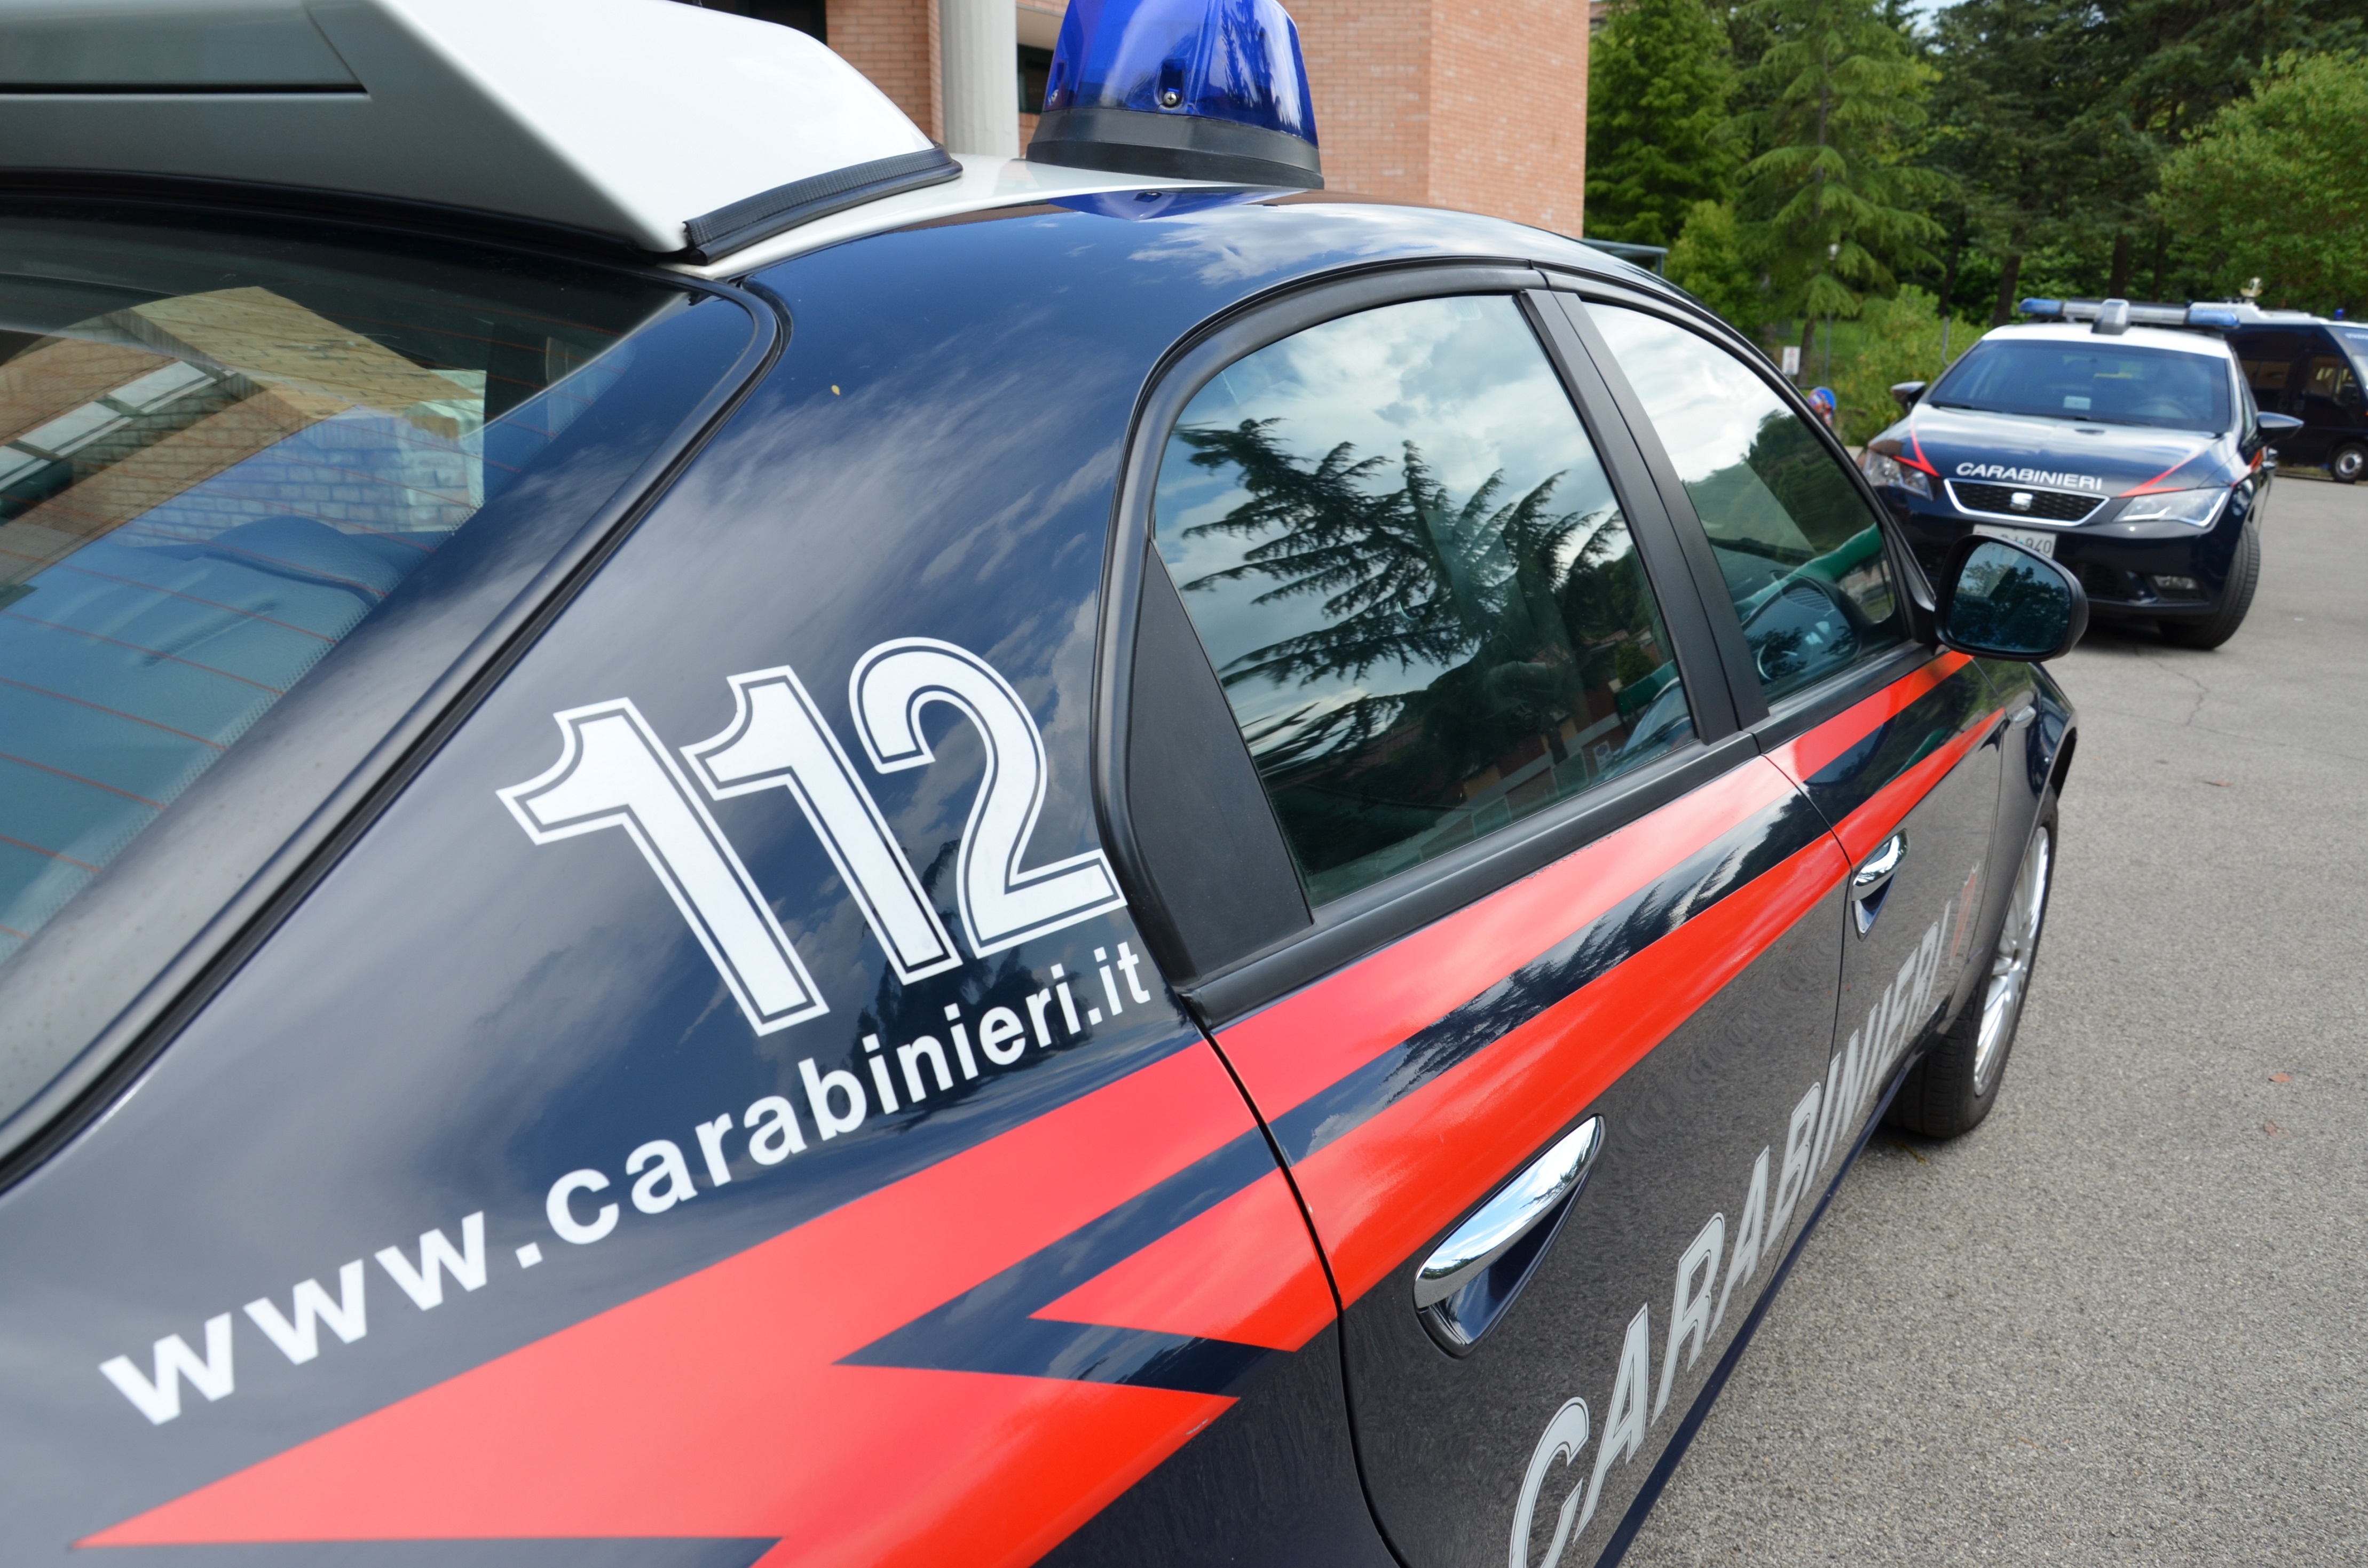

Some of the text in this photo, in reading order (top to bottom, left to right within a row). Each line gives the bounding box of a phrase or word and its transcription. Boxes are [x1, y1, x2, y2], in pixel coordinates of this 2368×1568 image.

[1956, 462, 2102, 490] CARABINIERI
[495, 636, 1128, 1036] 112
[99, 941, 1151, 1426] www.carabinieri.it
[1509, 900, 1952, 1568] CARABINIERI
